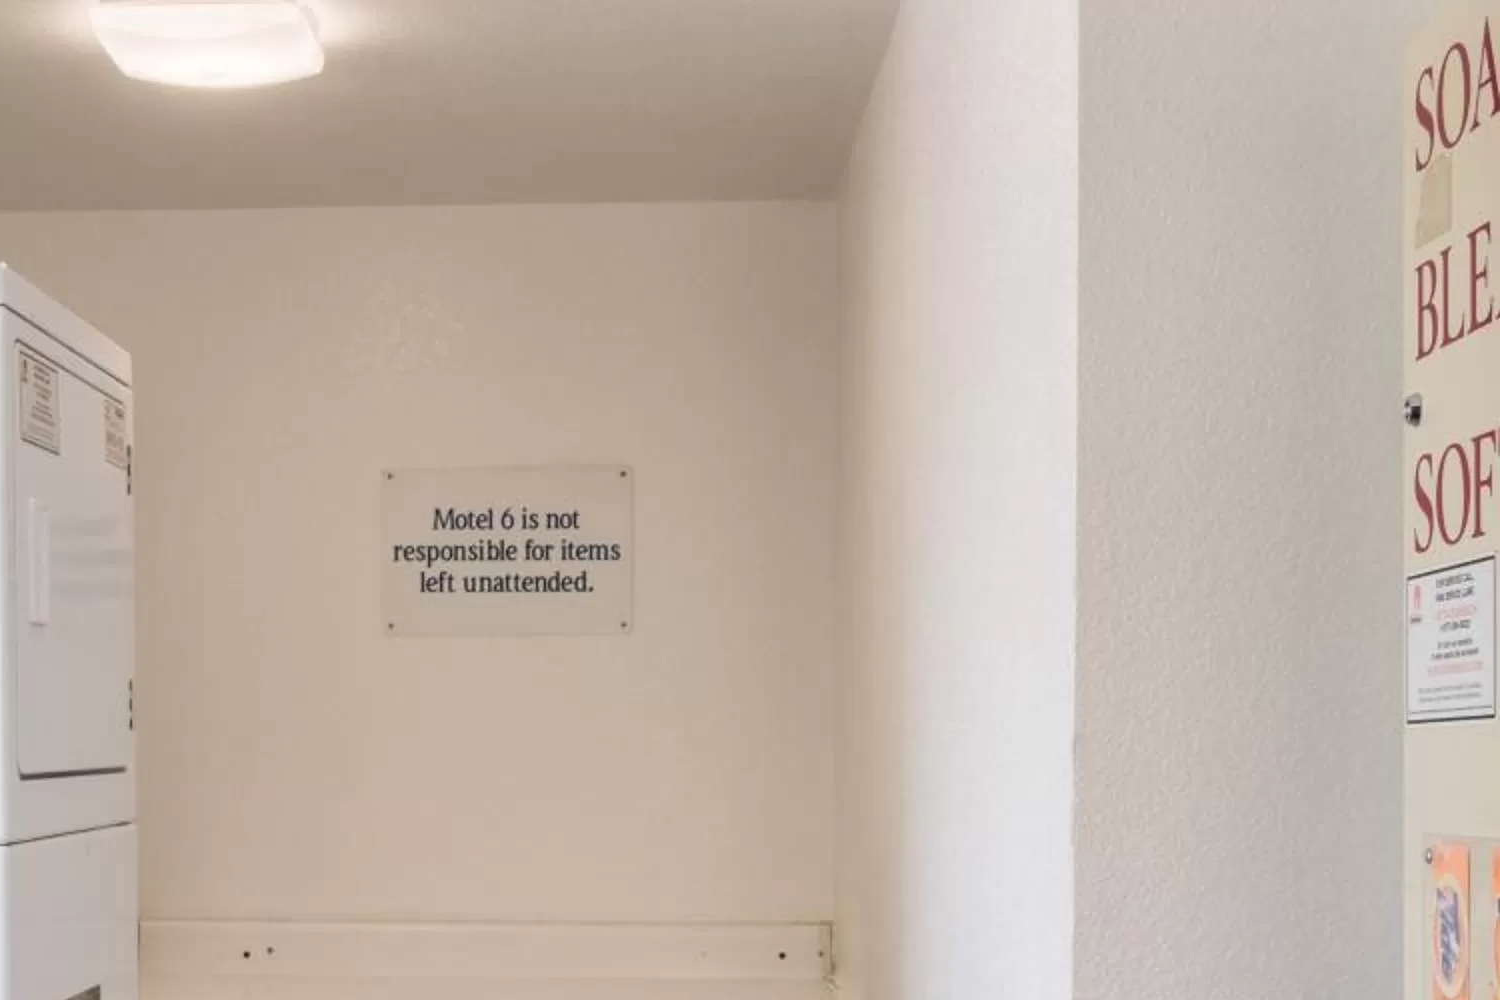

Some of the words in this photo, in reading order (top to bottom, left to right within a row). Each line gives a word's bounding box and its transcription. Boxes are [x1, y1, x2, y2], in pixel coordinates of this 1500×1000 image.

[1415, 16, 1500, 172] SOA
[1414, 220, 1500, 361] BLE
[432, 507, 493, 531] Motel
[501, 507, 515, 530] 6
[522, 507, 539, 530] is
[546, 510, 581, 530] not
[1414, 427, 1500, 554] SOF
[393, 539, 518, 568] responsible
[525, 538, 554, 561] for
[561, 539, 621, 561] items
[419, 571, 455, 593] left
[463, 570, 595, 593] unattended.
